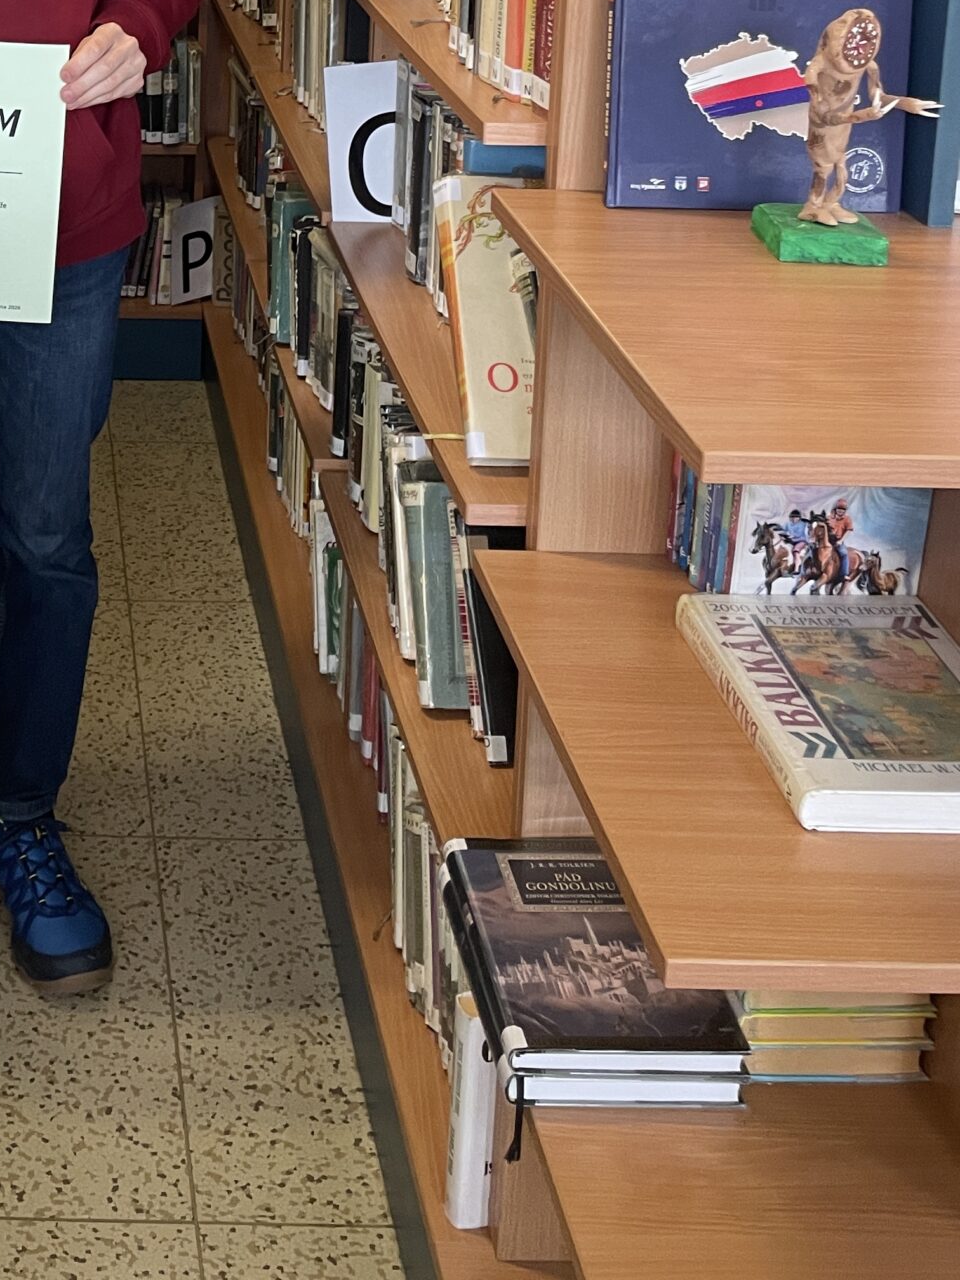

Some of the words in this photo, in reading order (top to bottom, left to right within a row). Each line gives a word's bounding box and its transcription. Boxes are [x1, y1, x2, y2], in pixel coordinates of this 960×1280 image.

[182, 230, 213, 294] P
[487, 362, 519, 393] O
[711, 603, 751, 615] 2000
[756, 604, 782, 615] LET
[788, 604, 825, 615] MEZI
[827, 603, 918, 616] VÝCHODEM
[763, 616, 778, 626] A
[781, 616, 855, 627] ZÁPADEM
[715, 615, 825, 729] BALKÁN
[852, 761, 927, 774] MICHAEL
[553, 871, 582, 882] PÁD
[525, 881, 617, 891] GONDOLINU
